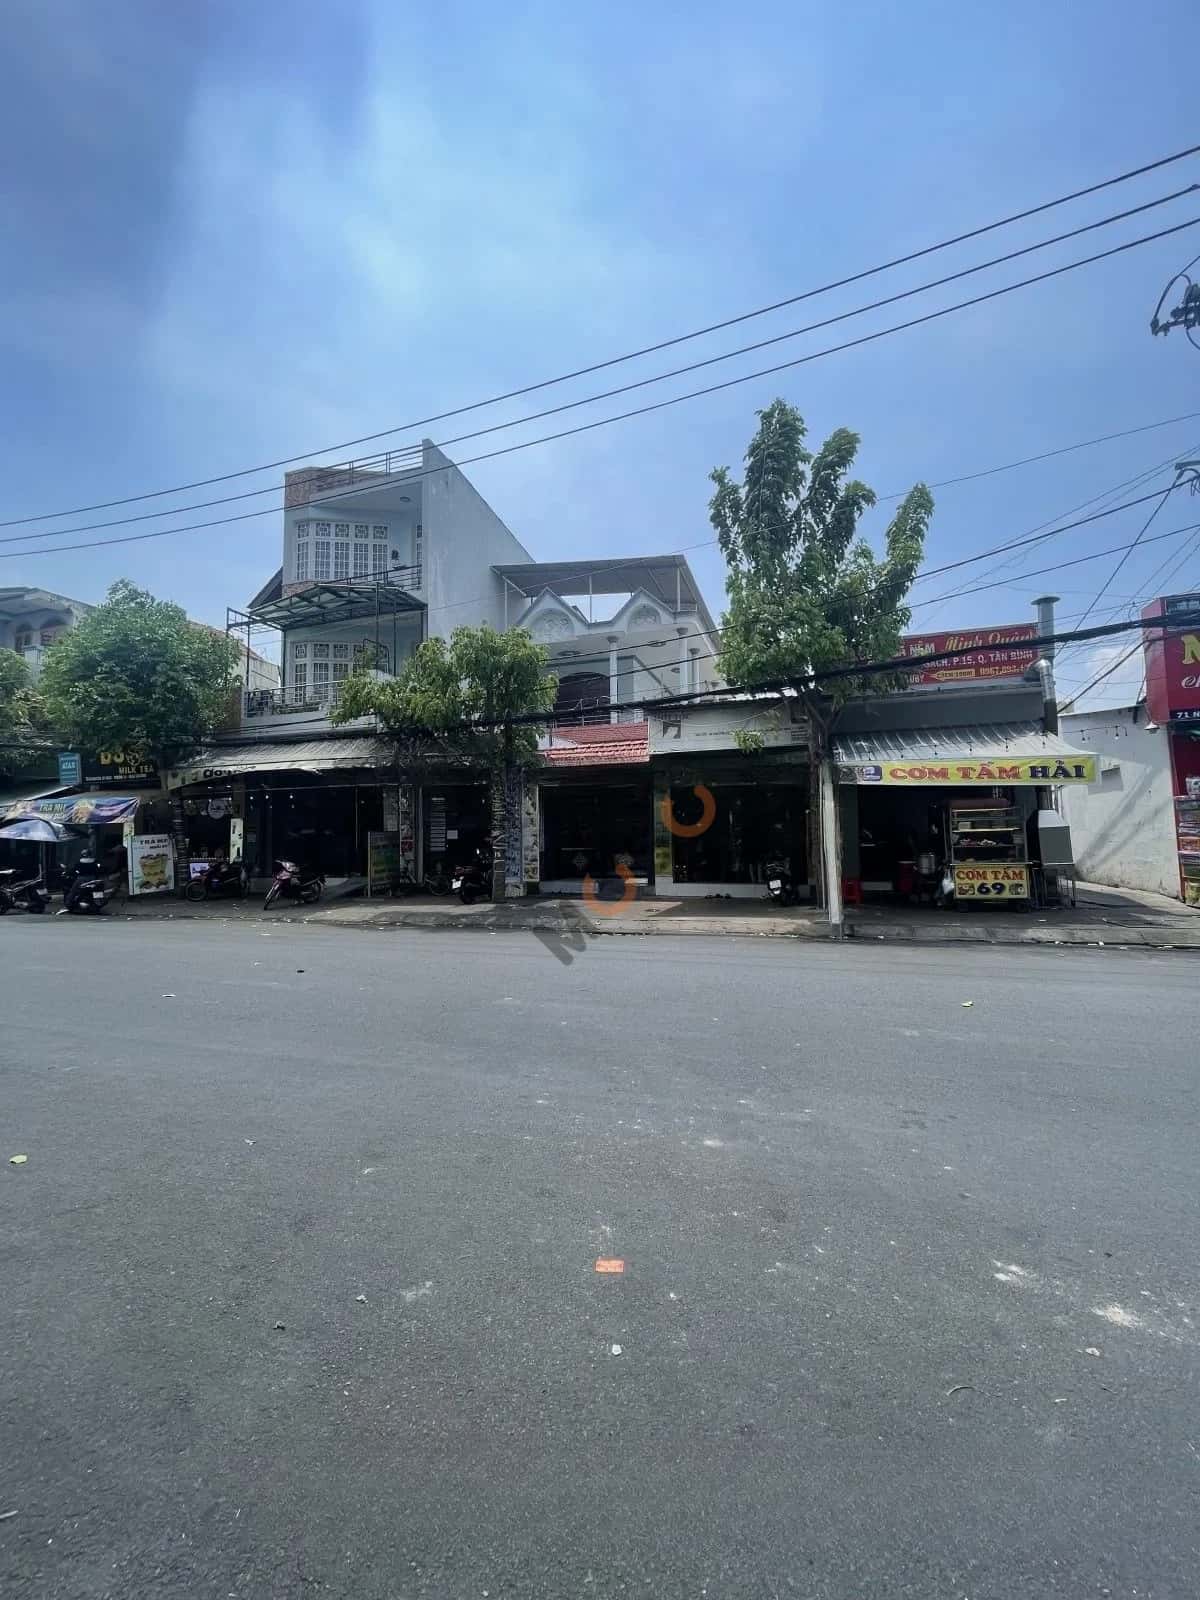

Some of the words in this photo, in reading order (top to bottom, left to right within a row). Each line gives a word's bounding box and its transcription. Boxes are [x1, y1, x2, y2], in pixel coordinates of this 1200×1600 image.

[889, 765, 949, 781] CƠM
[1029, 760, 1087, 779] HẢI
[977, 881, 1006, 895] 69
